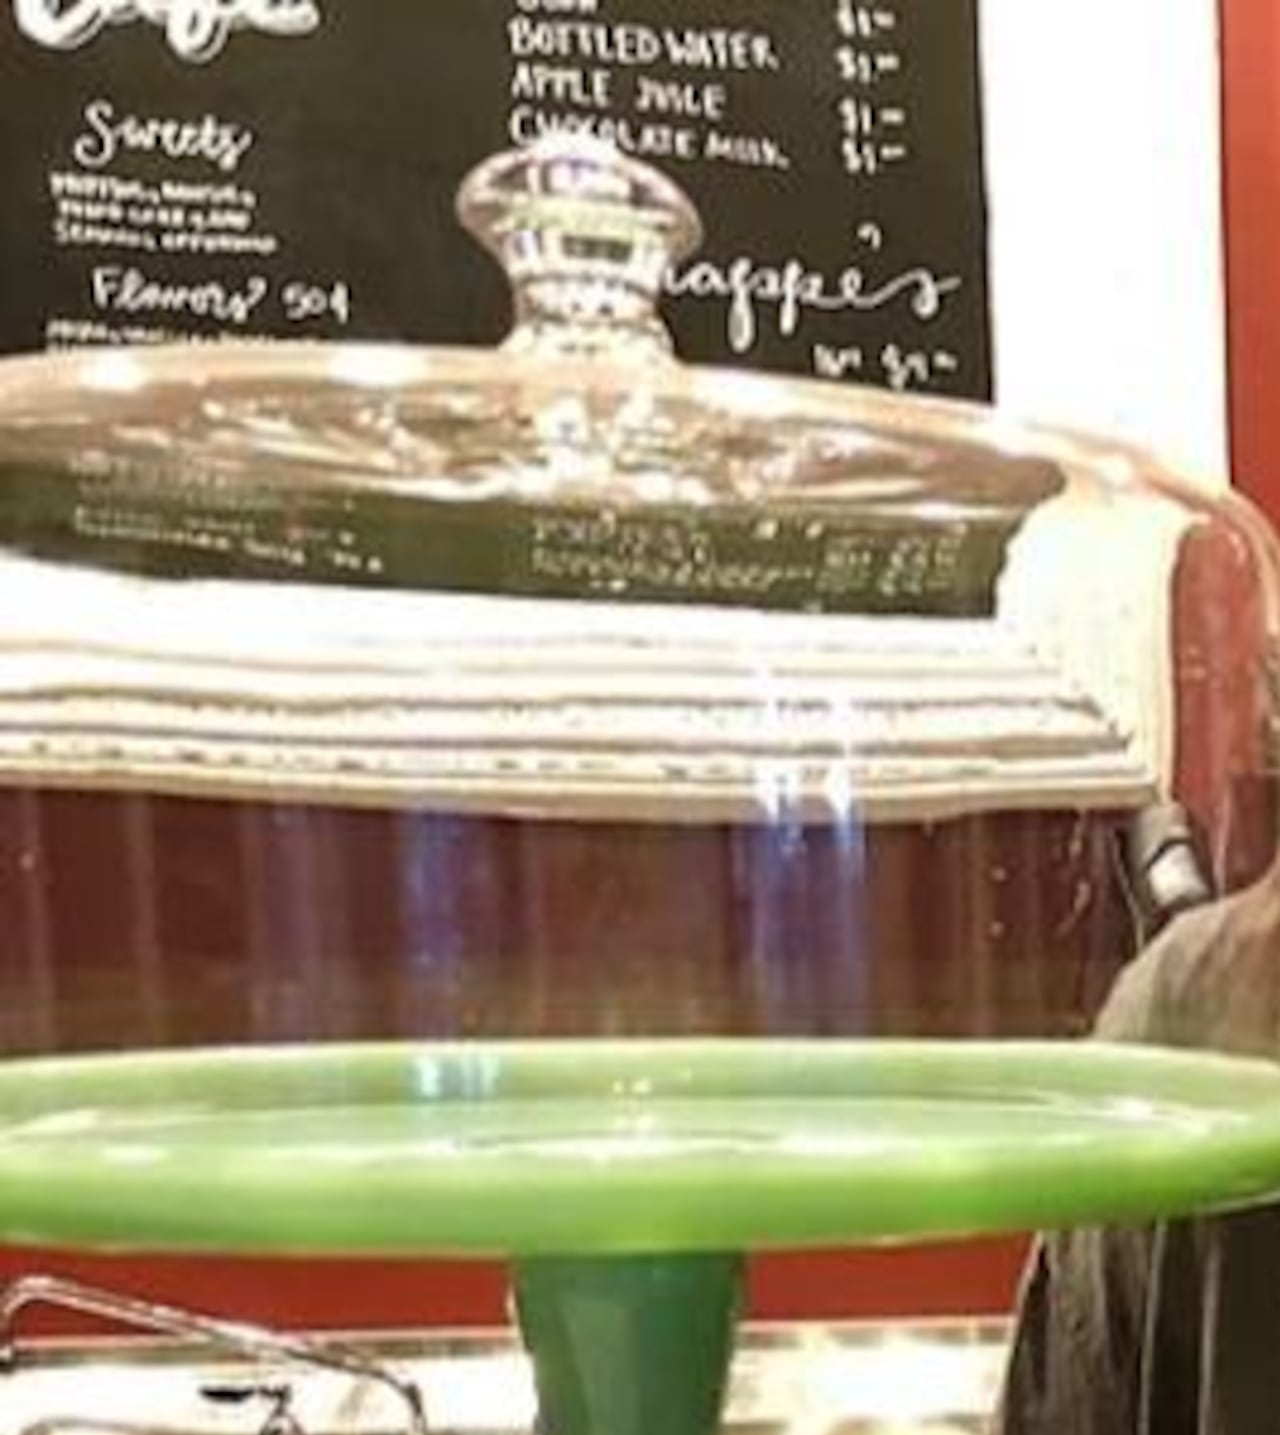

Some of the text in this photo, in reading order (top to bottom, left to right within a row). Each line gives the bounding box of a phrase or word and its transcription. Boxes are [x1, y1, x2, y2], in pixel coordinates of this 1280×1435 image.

[508, 14, 780, 71] BOTTLED WATER
[510, 60, 612, 108] APPLE
[73, 99, 254, 170] Sweets
